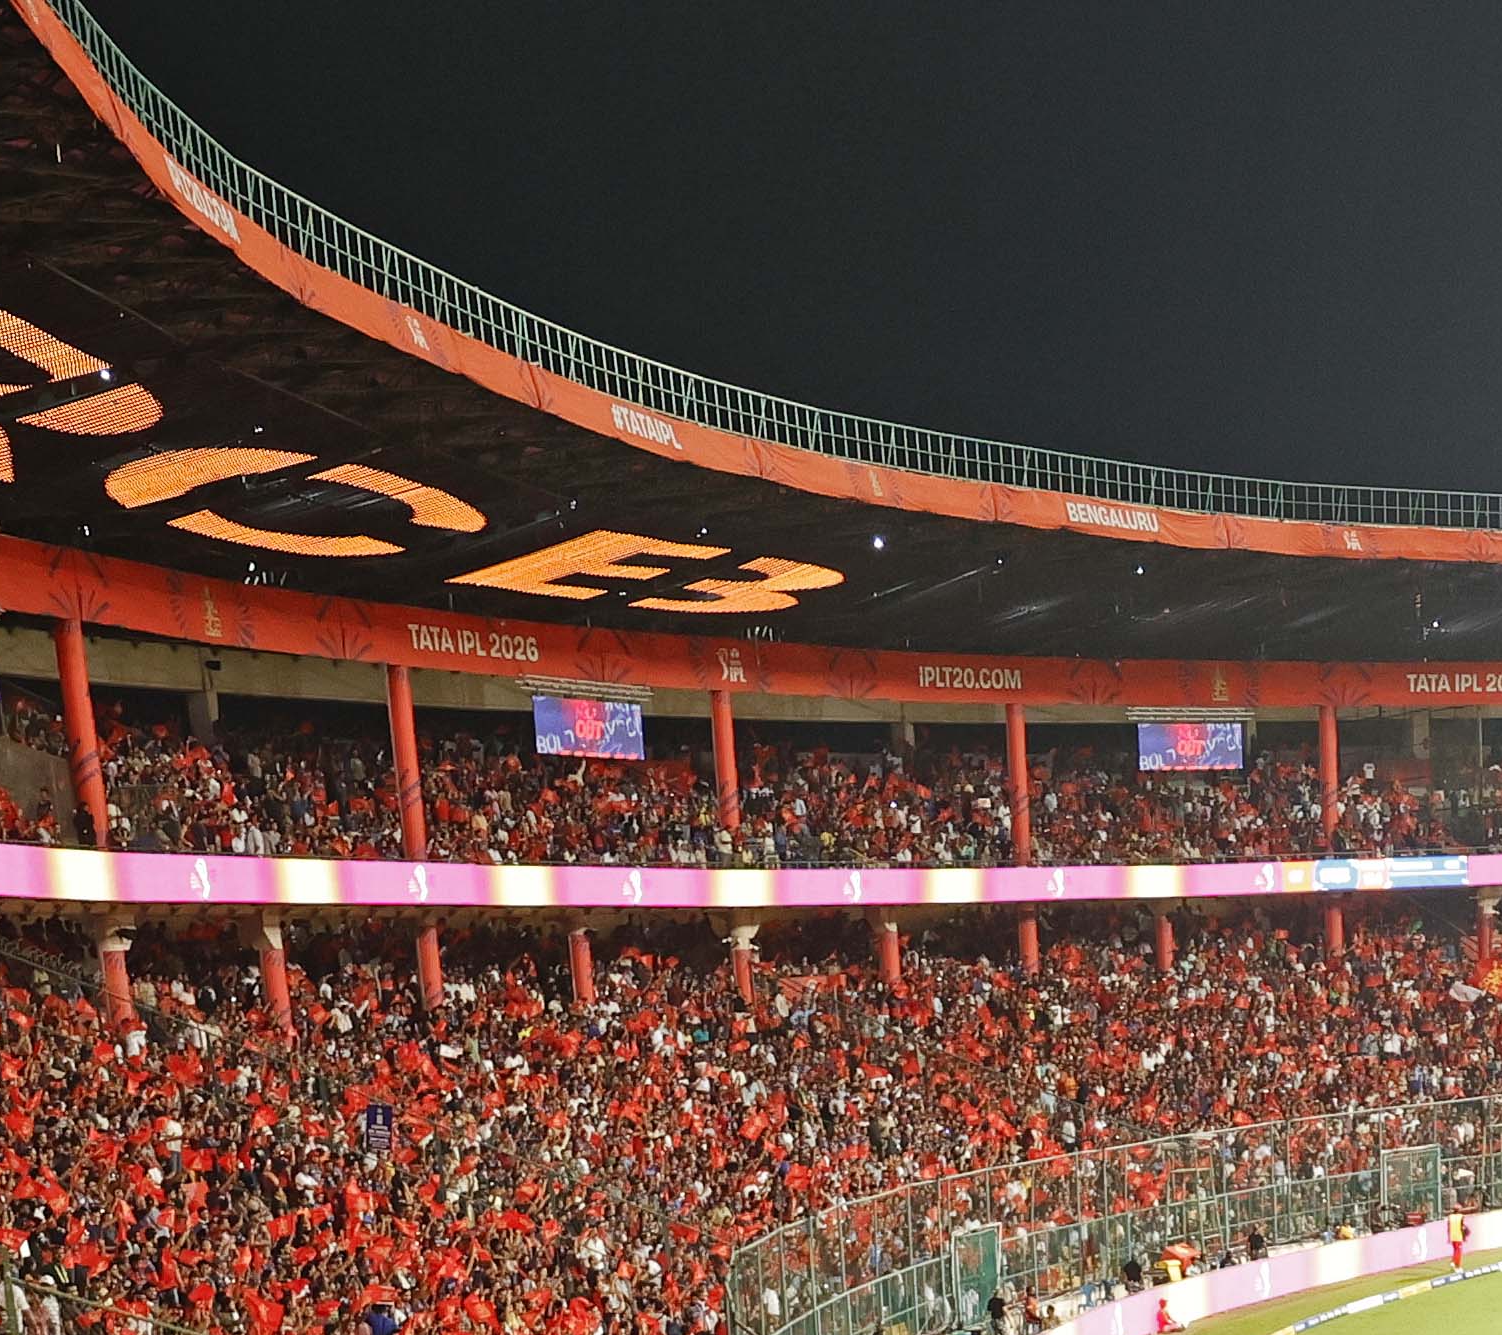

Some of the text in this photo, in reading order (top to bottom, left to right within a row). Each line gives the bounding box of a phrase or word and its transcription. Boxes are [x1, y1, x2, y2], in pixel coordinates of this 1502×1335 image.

[1065, 501, 1160, 533] BENGALURU
[407, 623, 540, 663] TATA IPL 2026
[919, 665, 1023, 690] IPLT20.COM
[1406, 673, 1452, 693] TATA
[1454, 673, 1483, 693] IPL
